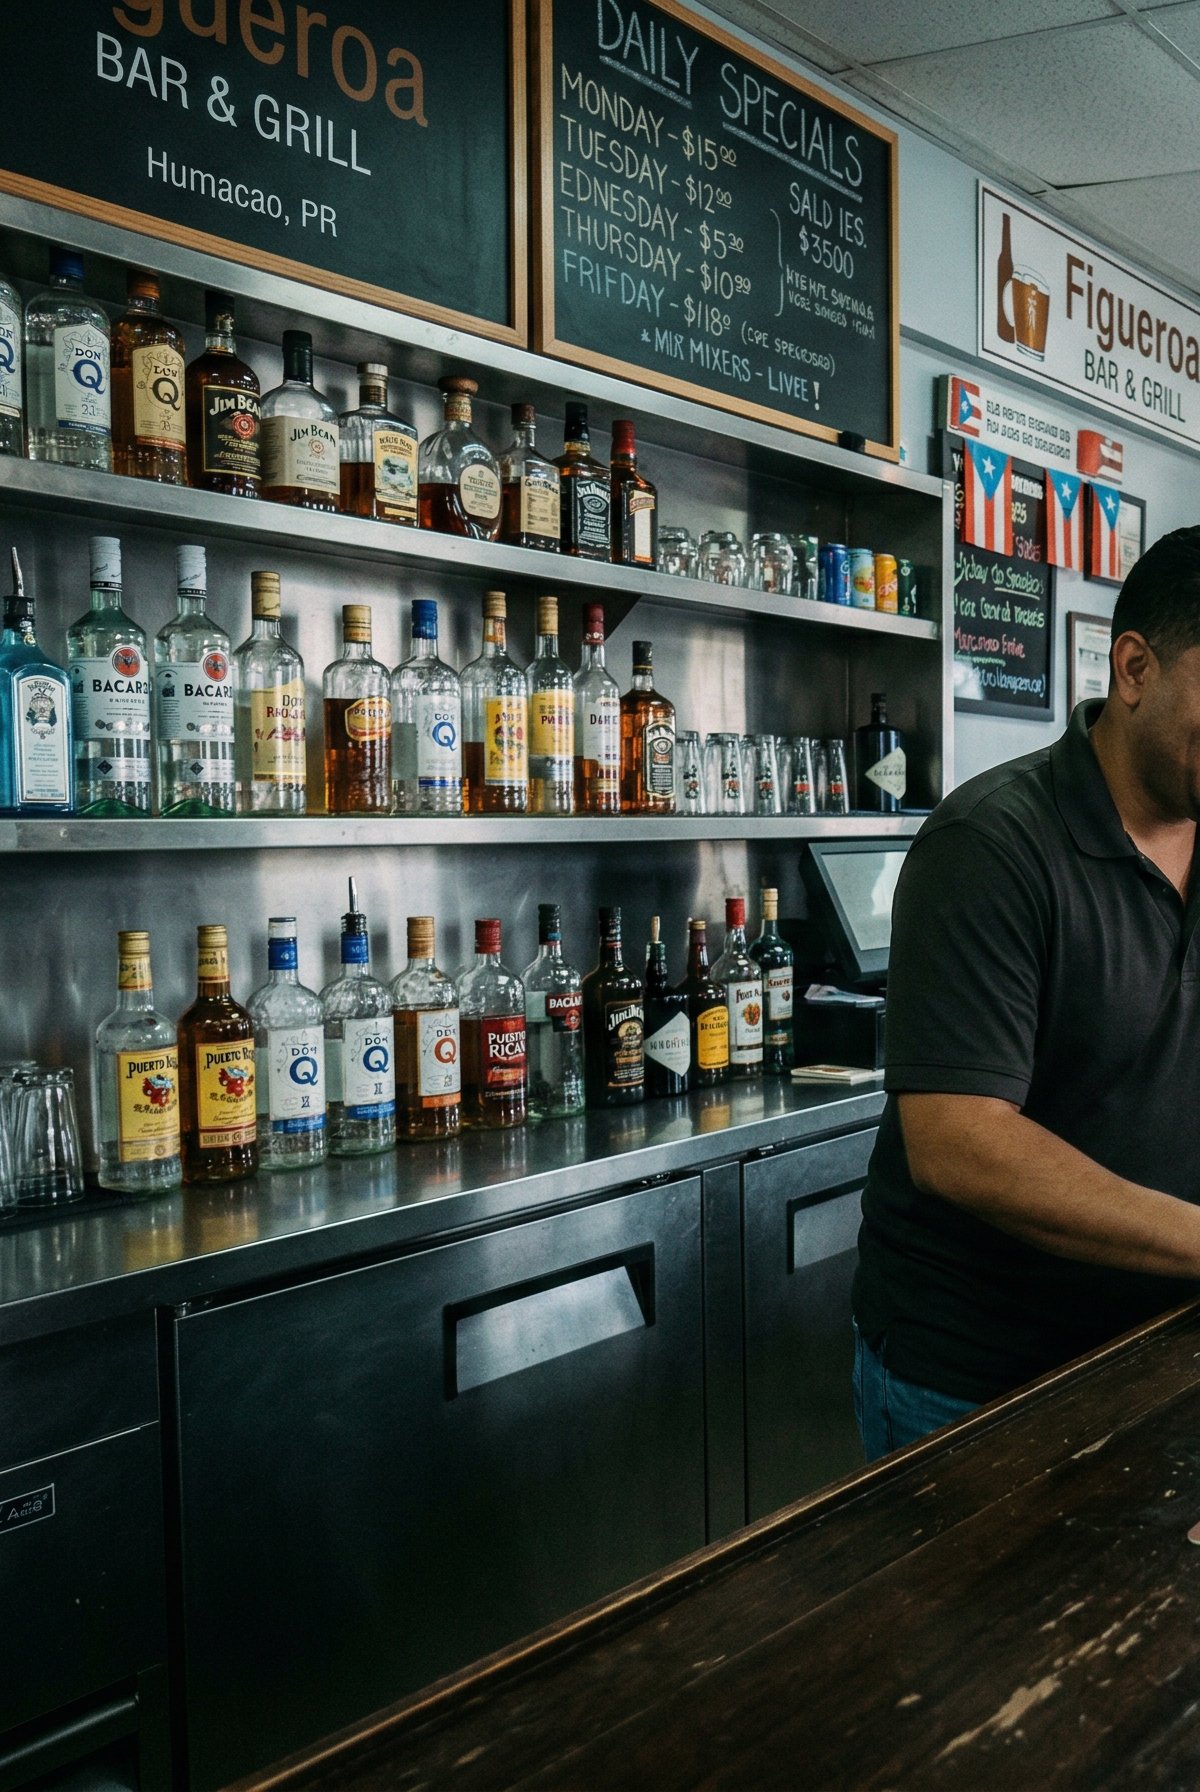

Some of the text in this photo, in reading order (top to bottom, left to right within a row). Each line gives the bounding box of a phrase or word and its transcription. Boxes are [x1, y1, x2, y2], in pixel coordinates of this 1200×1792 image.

[96, 31, 372, 176] BAR & GRILL
[561, 63, 664, 148] MONDAY
[597, 0, 863, 187] DAILY SPECIALS
[560, 114, 668, 194] TUESDAY
[147, 146, 338, 238] Humacao, PR
[560, 161, 679, 242] EDNESDAY
[561, 205, 681, 282] THURSDAY
[799, 226, 854, 279] $3500
[563, 248, 665, 318] FRIFDAY
[1066, 252, 1200, 384] Figueroa
[72, 359, 106, 394] Q
[75, 347, 101, 360] DON
[690, 338, 751, 383] MIXERS
[1084, 349, 1186, 423] BAR & GRILL
[151, 377, 180, 411] Q
[432, 721, 457, 751] Q
[289, 1056, 319, 1086] Q
[362, 1045, 389, 1073] Q
[434, 1037, 457, 1065] Q
